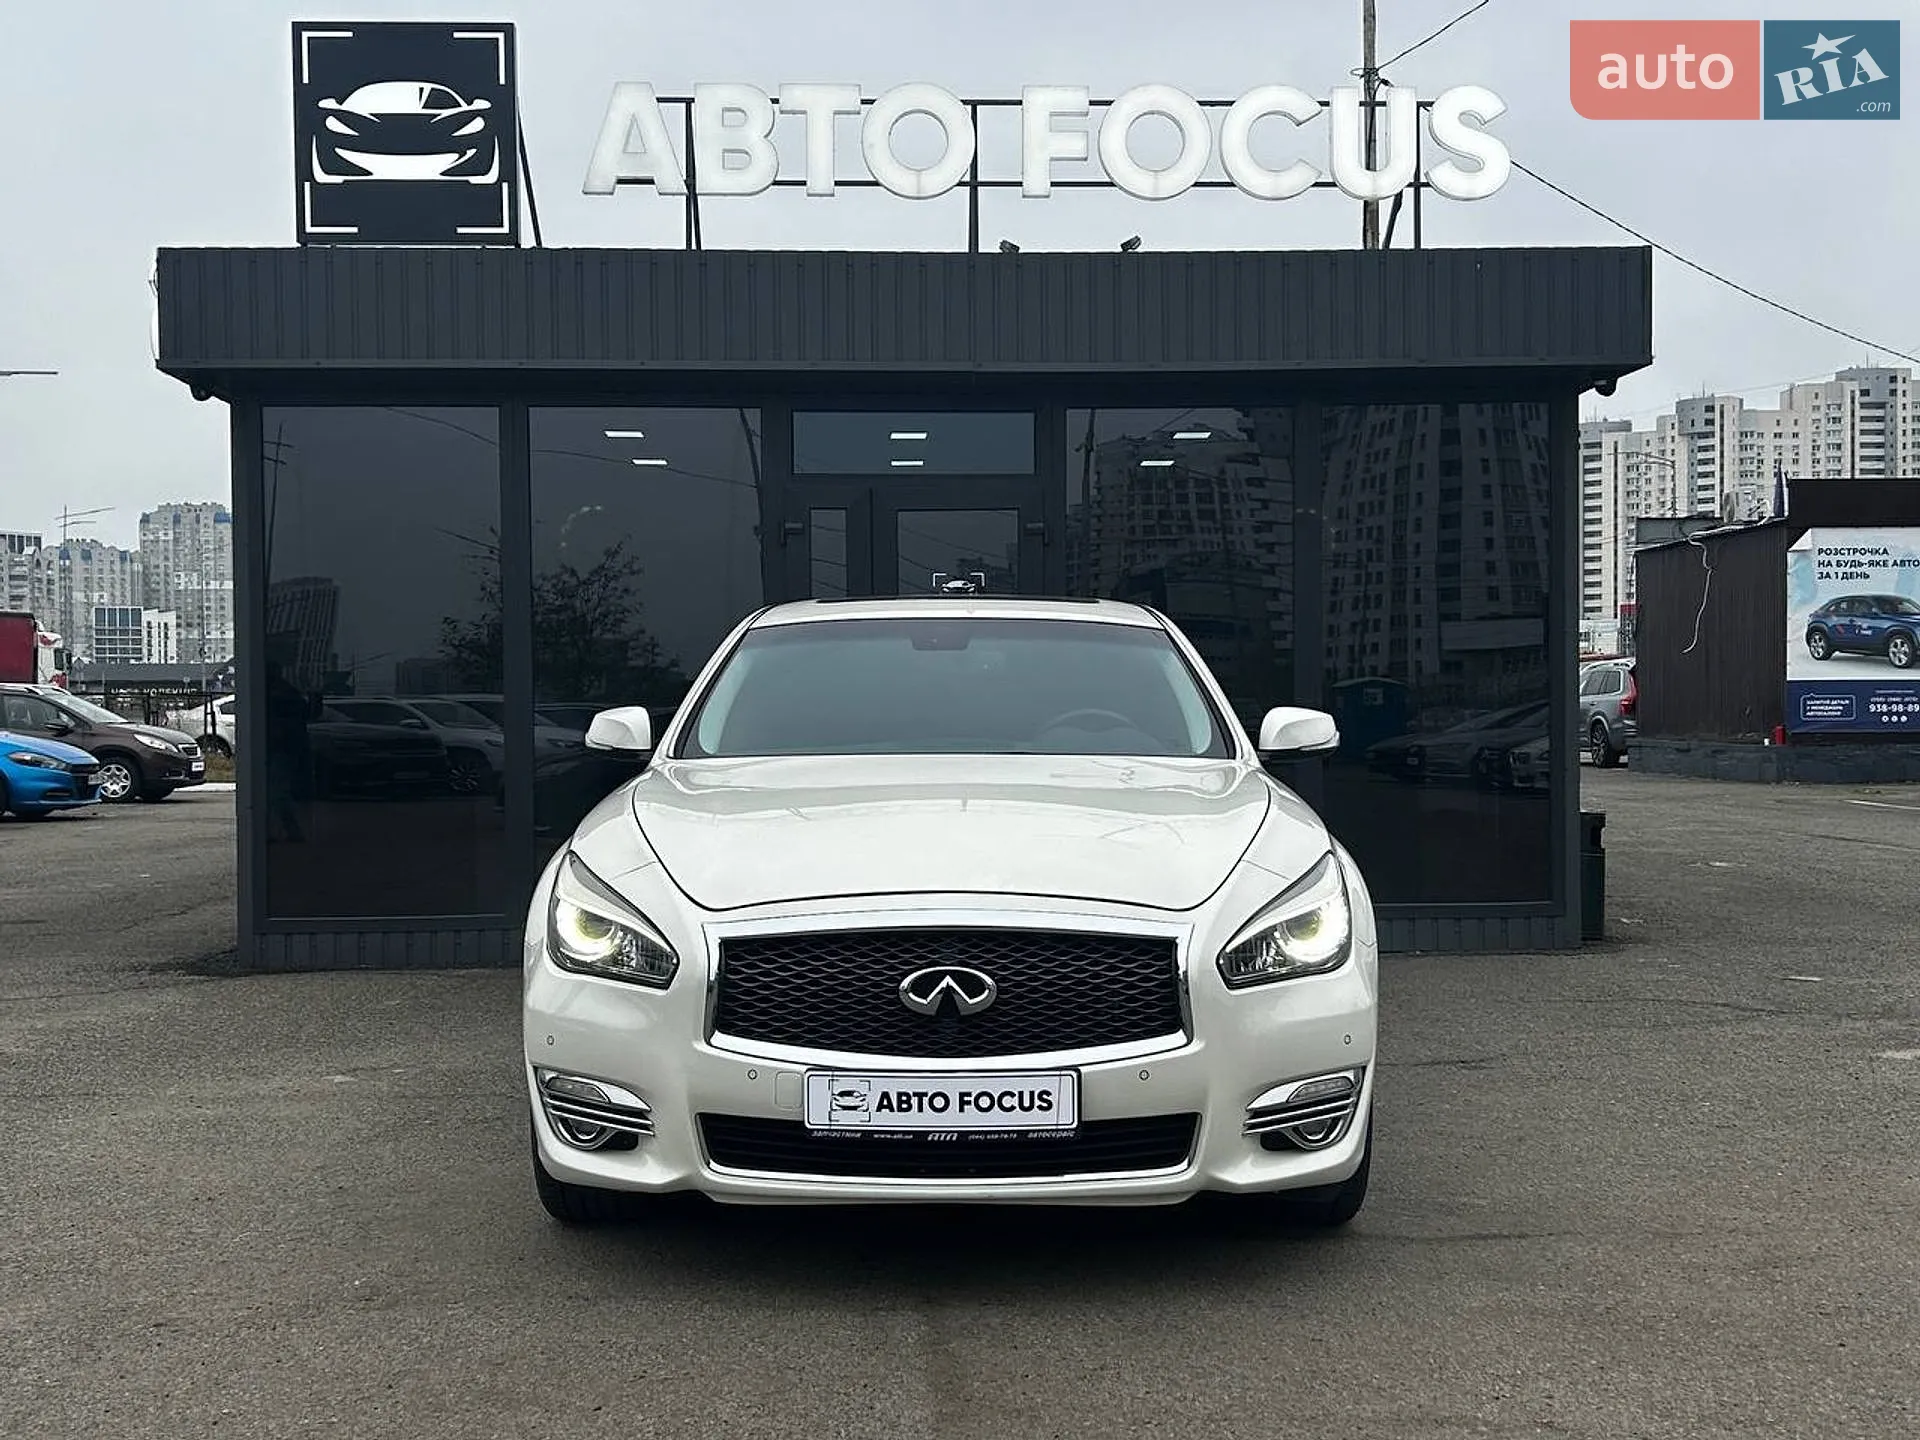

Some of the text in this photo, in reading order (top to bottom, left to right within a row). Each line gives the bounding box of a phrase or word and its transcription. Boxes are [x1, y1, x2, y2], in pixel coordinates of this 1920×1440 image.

[582, 82, 1512, 200] АВТО FOCUS
[1817, 547, 1889, 556] РОЗСТРОЧКА
[1817, 560, 1832, 568] НА
[1836, 560, 1889, 569] БУДЬ-ЯКЕ
[1817, 572, 1832, 580] ЗА
[1841, 572, 1870, 581] ДЕНЬ
[875, 1090, 1053, 1113] АВТО FOCUS
